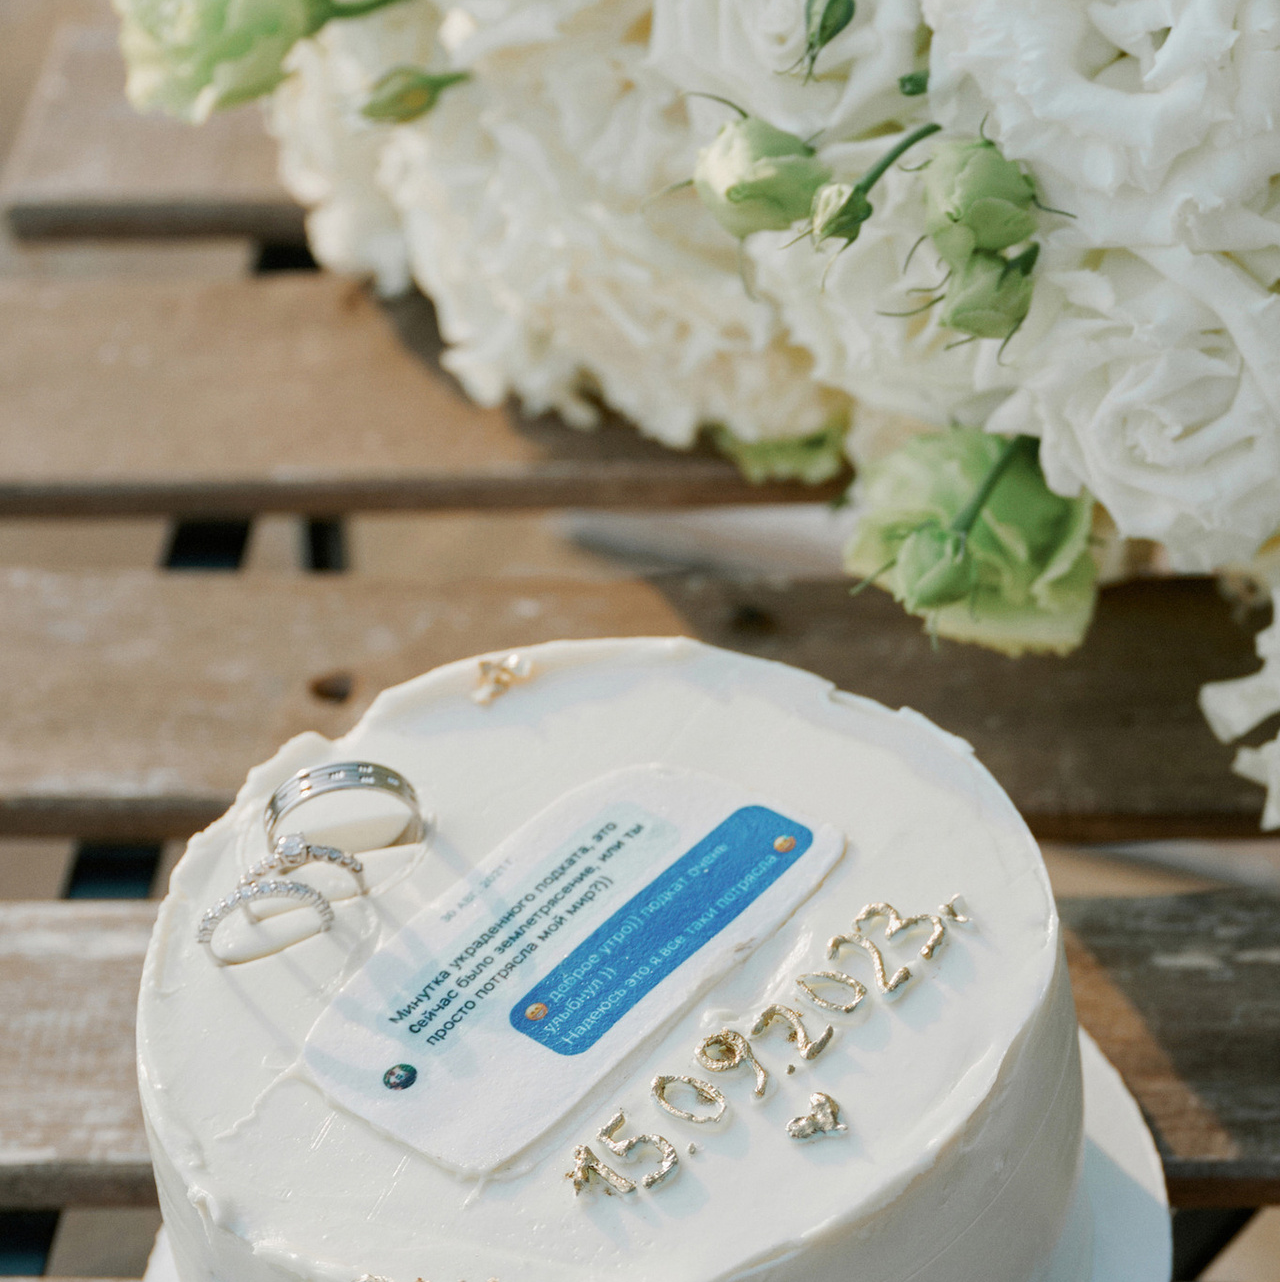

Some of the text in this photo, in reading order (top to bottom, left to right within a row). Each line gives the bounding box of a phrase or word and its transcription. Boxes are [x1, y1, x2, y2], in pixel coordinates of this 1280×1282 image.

[388, 822, 617, 1024] Минутка украденного подката, это
[426, 875, 614, 1046] просто потрясла мой мир?))
[455, 955, 494, 988] было
[494, 866, 601, 955] землетрясение,
[598, 840, 625, 862] или
[623, 823, 644, 838] ты
[549, 844, 729, 1002] доброе утро)) подкат очень
[561, 854, 777, 1045] Надеюсь это я все таки потрясла
[543, 978, 603, 1035] улыбнул
